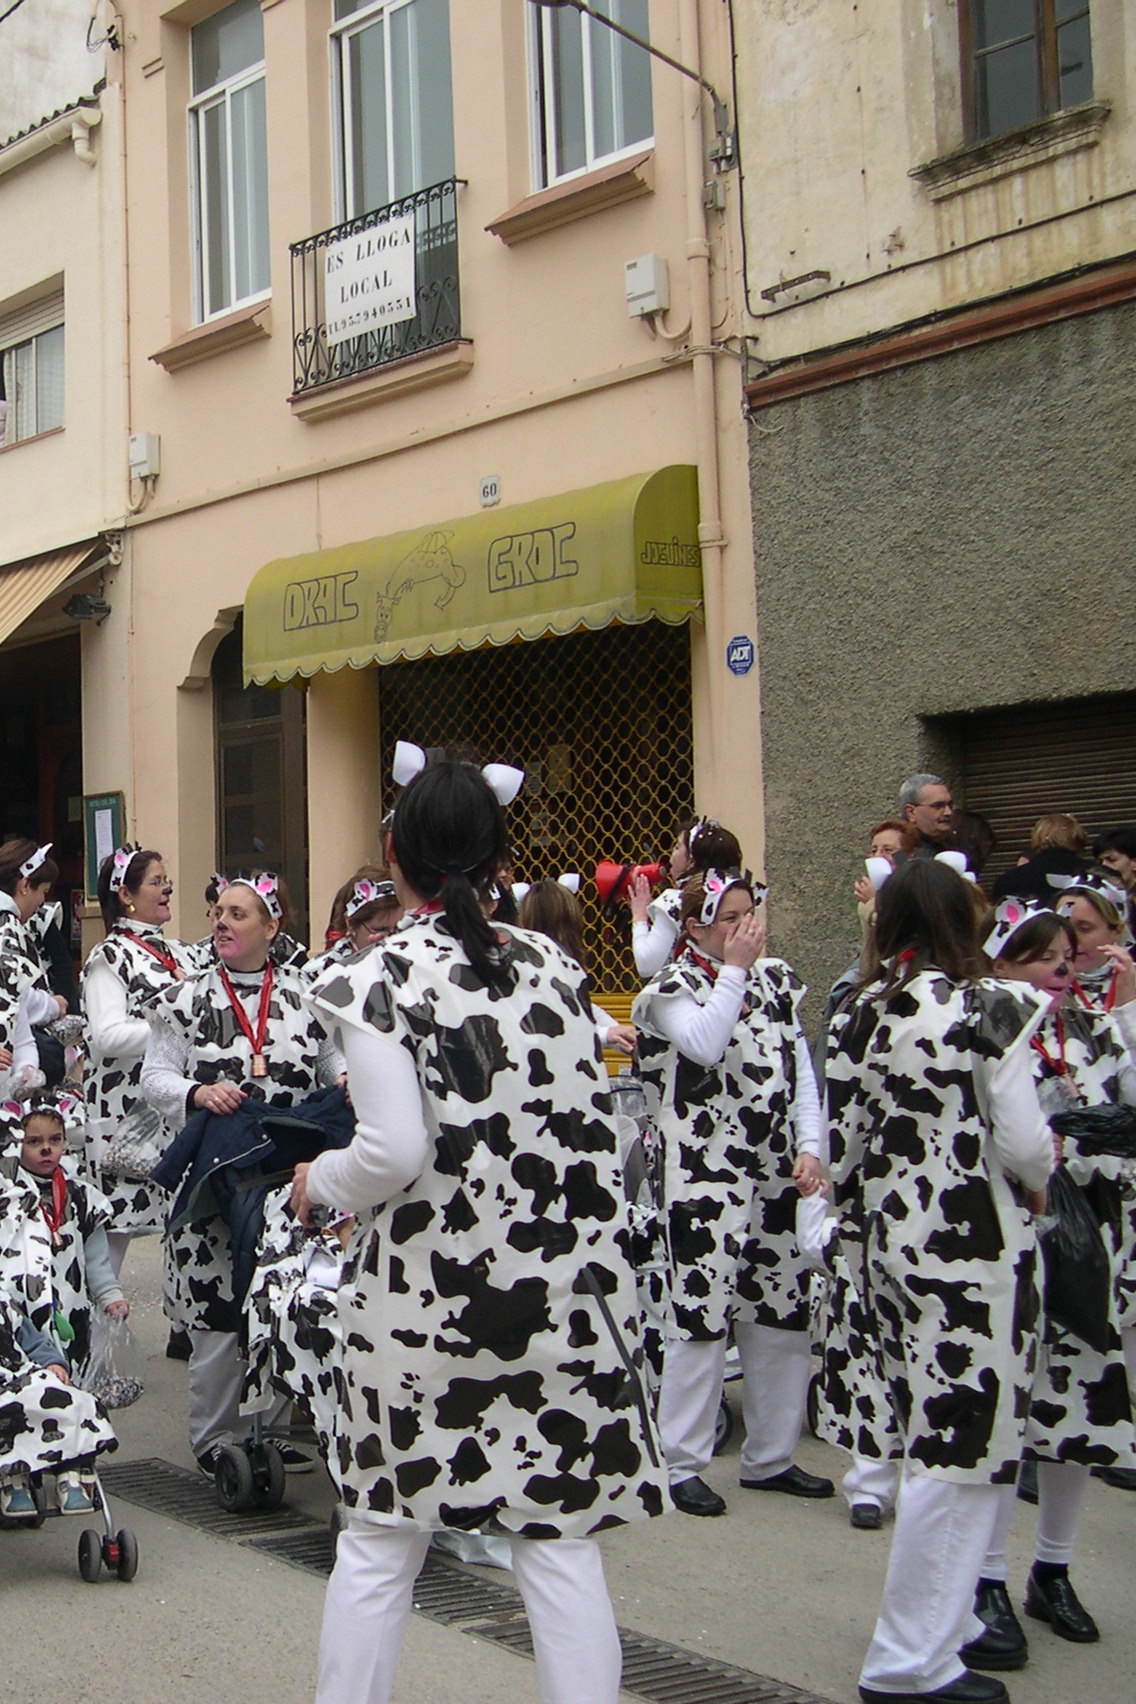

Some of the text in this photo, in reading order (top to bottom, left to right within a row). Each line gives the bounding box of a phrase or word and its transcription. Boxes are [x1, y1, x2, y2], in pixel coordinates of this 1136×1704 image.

[327, 227, 411, 274] ES LLOGA
[340, 269, 392, 304] LOCAL
[482, 482, 497, 498] 60
[283, 521, 579, 632] DRAC GROC
[730, 646, 751, 662] ADT
